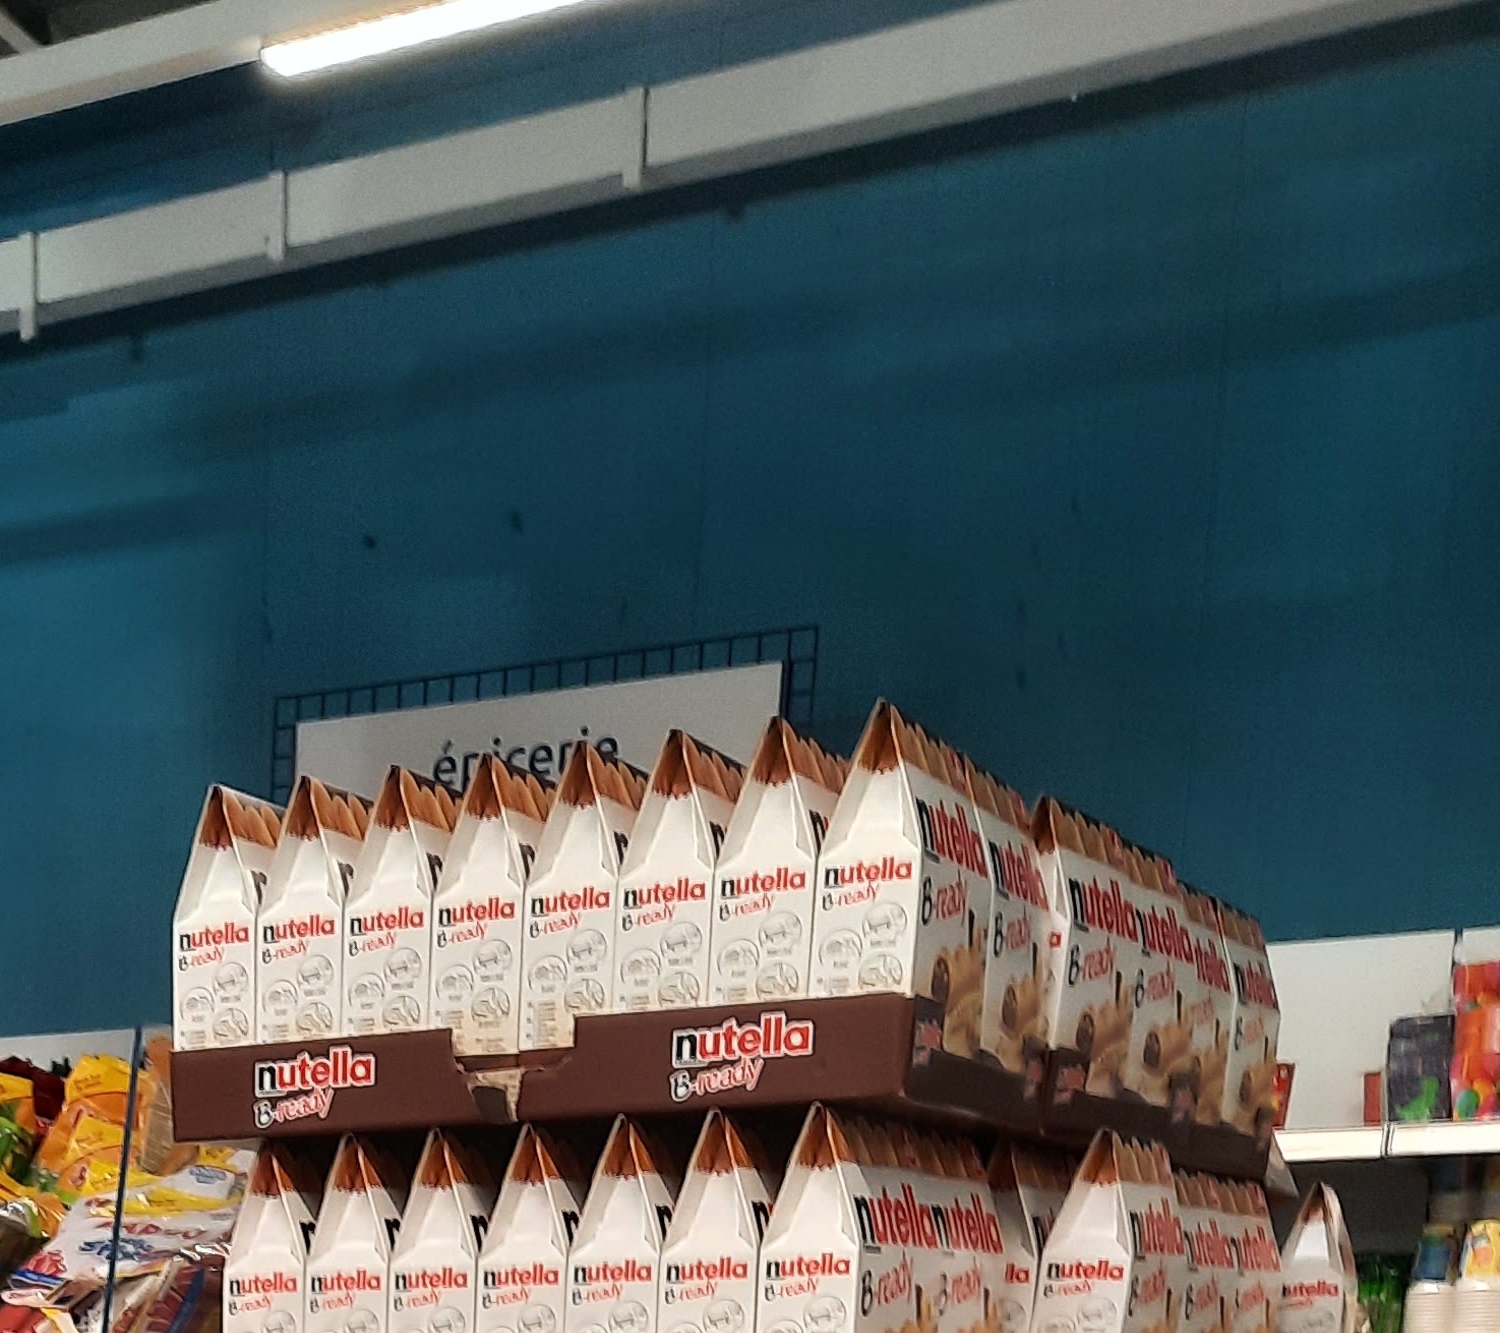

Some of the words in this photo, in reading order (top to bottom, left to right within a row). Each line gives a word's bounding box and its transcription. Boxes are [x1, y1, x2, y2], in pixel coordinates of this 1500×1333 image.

[434, 727, 618, 787] épcere
[720, 866, 807, 900] nutella
[823, 856, 913, 890] nutella
[530, 887, 611, 918] nutella
[623, 875, 707, 909] nutella
[350, 907, 425, 936] nutella
[438, 898, 517, 928] nutella
[1068, 876, 1138, 945] nutella
[179, 923, 250, 951] nutella
[262, 915, 336, 944] nutella
[673, 1011, 814, 1068] nutella
[256, 1047, 375, 1096] nutella
[670, 1056, 764, 1102] B-ready
[254, 1088, 335, 1128] B-ready
[854, 1183, 936, 1252] nutella
[394, 1266, 469, 1292] nutella
[483, 1263, 560, 1289] nutella
[573, 1258, 652, 1284] nutella
[666, 1255, 748, 1282] nutella
[765, 1251, 851, 1280] nutella
[1046, 1257, 1124, 1282] nutella
[228, 1271, 298, 1297] nutella
[310, 1269, 382, 1295] nutella
